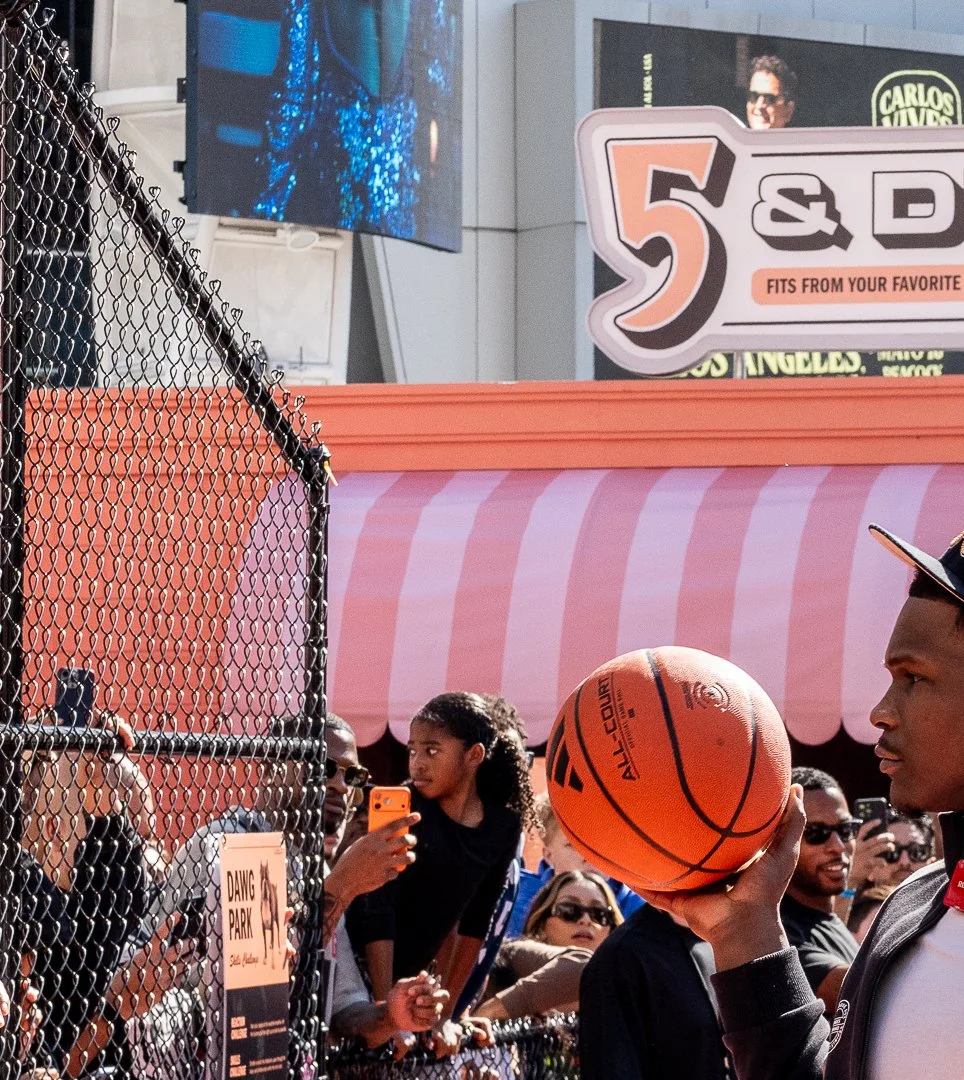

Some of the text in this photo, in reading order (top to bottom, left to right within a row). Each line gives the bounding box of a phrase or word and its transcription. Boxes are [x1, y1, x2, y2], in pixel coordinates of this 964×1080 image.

[879, 83, 954, 117] CARLOS
[605, 135, 736, 350] 5
[751, 172, 854, 252] &
[767, 278, 797, 294] FITS
[802, 277, 844, 294] FROM
[849, 276, 887, 293] YOUR
[893, 275, 961, 292] FAVORITE
[597, 676, 637, 782] ALL-COURT
[227, 869, 256, 903] DAWG
[229, 906, 254, 941] PARK
